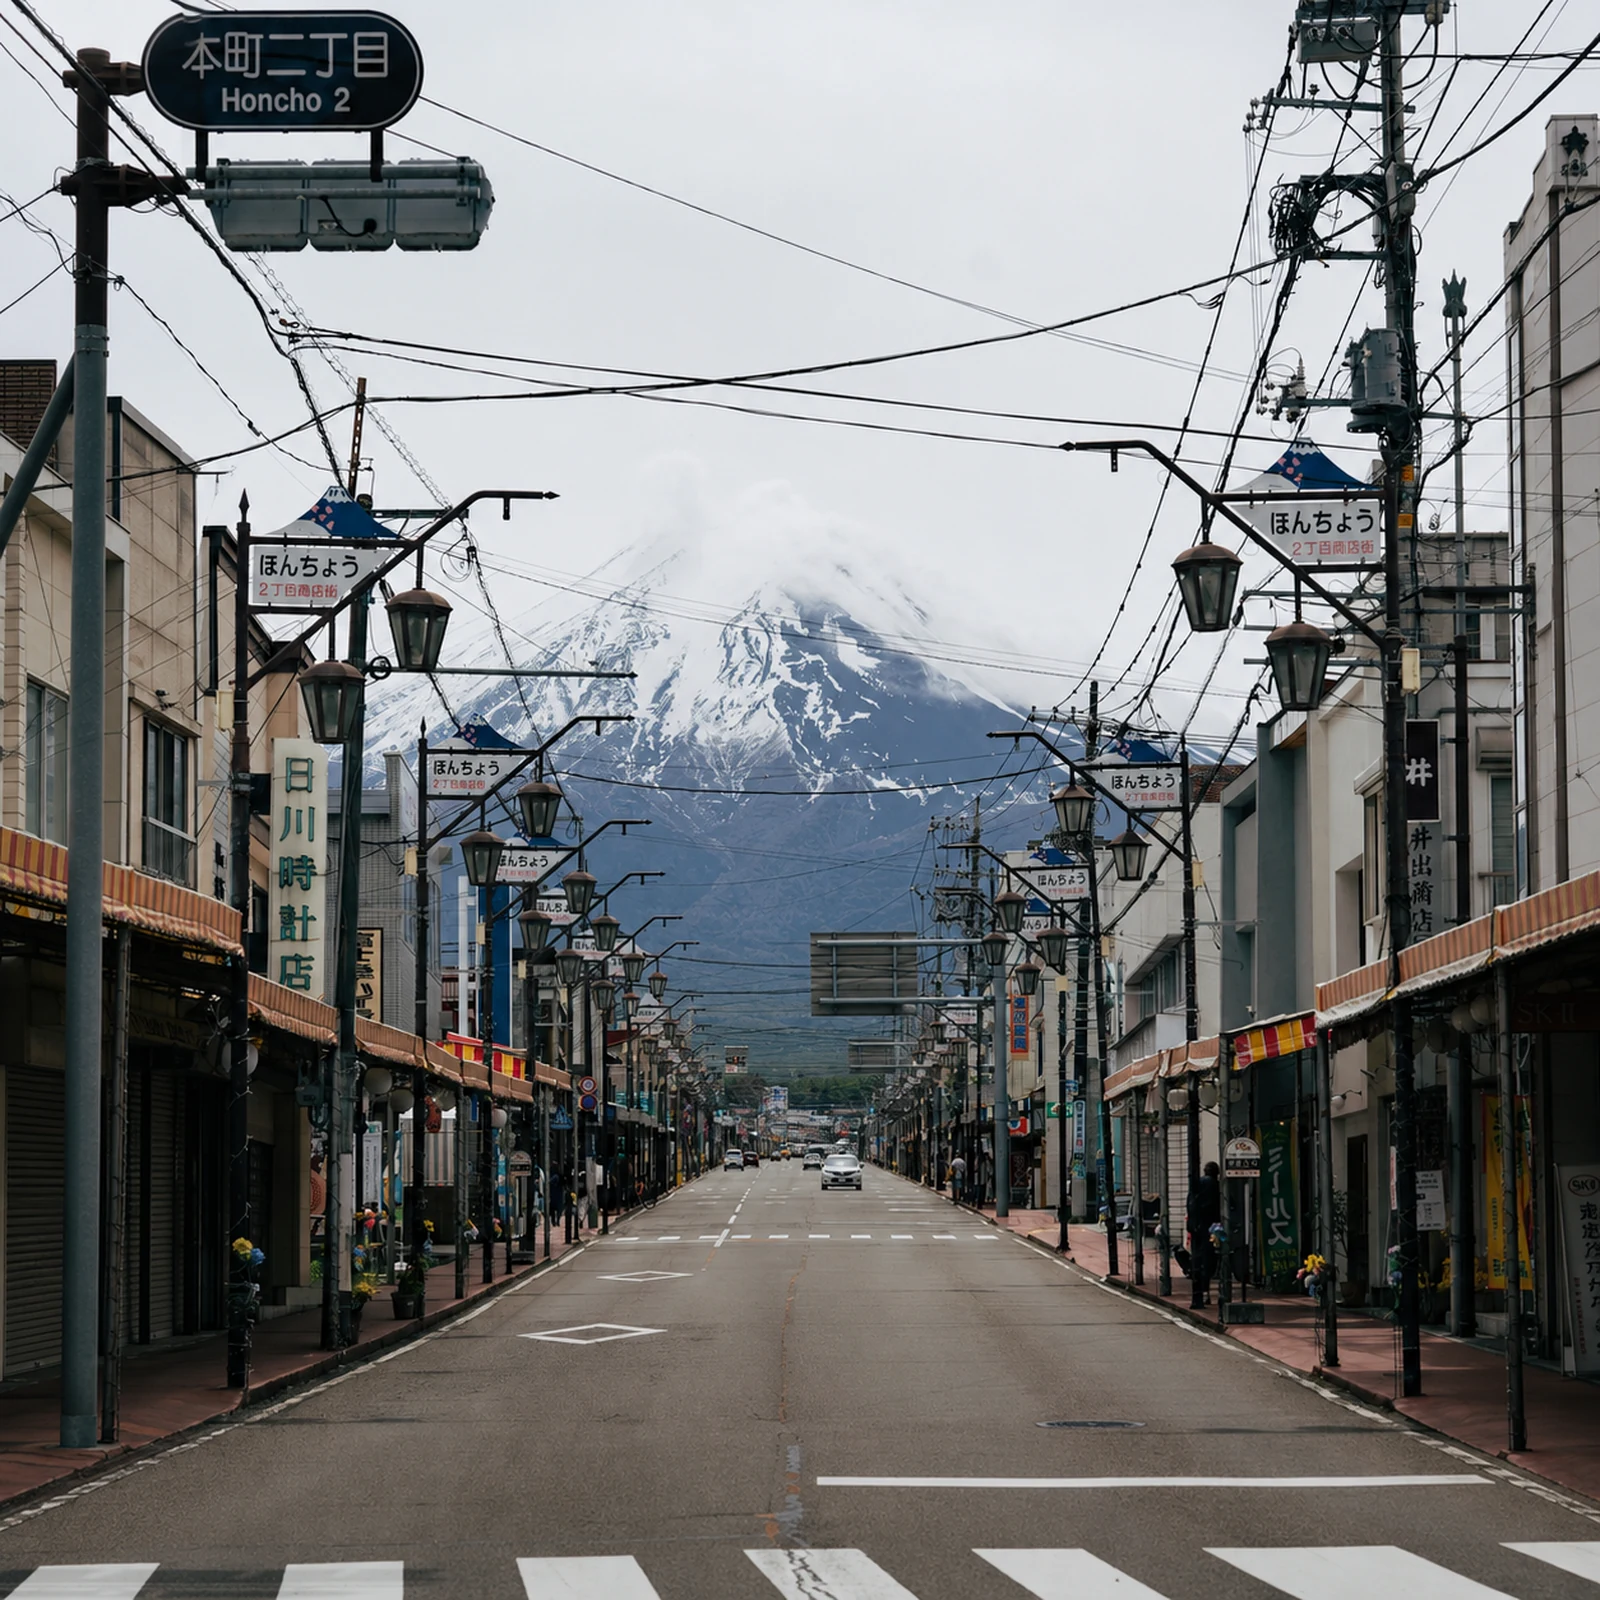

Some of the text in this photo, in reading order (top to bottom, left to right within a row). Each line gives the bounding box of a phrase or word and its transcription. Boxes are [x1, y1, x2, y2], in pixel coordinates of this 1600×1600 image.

[182, 32, 389, 79] 本町二丁目
[221, 87, 351, 113] Honcho 2
[1270, 508, 1374, 535] ほんちょう
[259, 554, 359, 578] ほんちょう
[433, 760, 500, 776] ほんちょう
[1111, 773, 1175, 790] ほんちょう
[279, 757, 318, 991] 日川時計店
